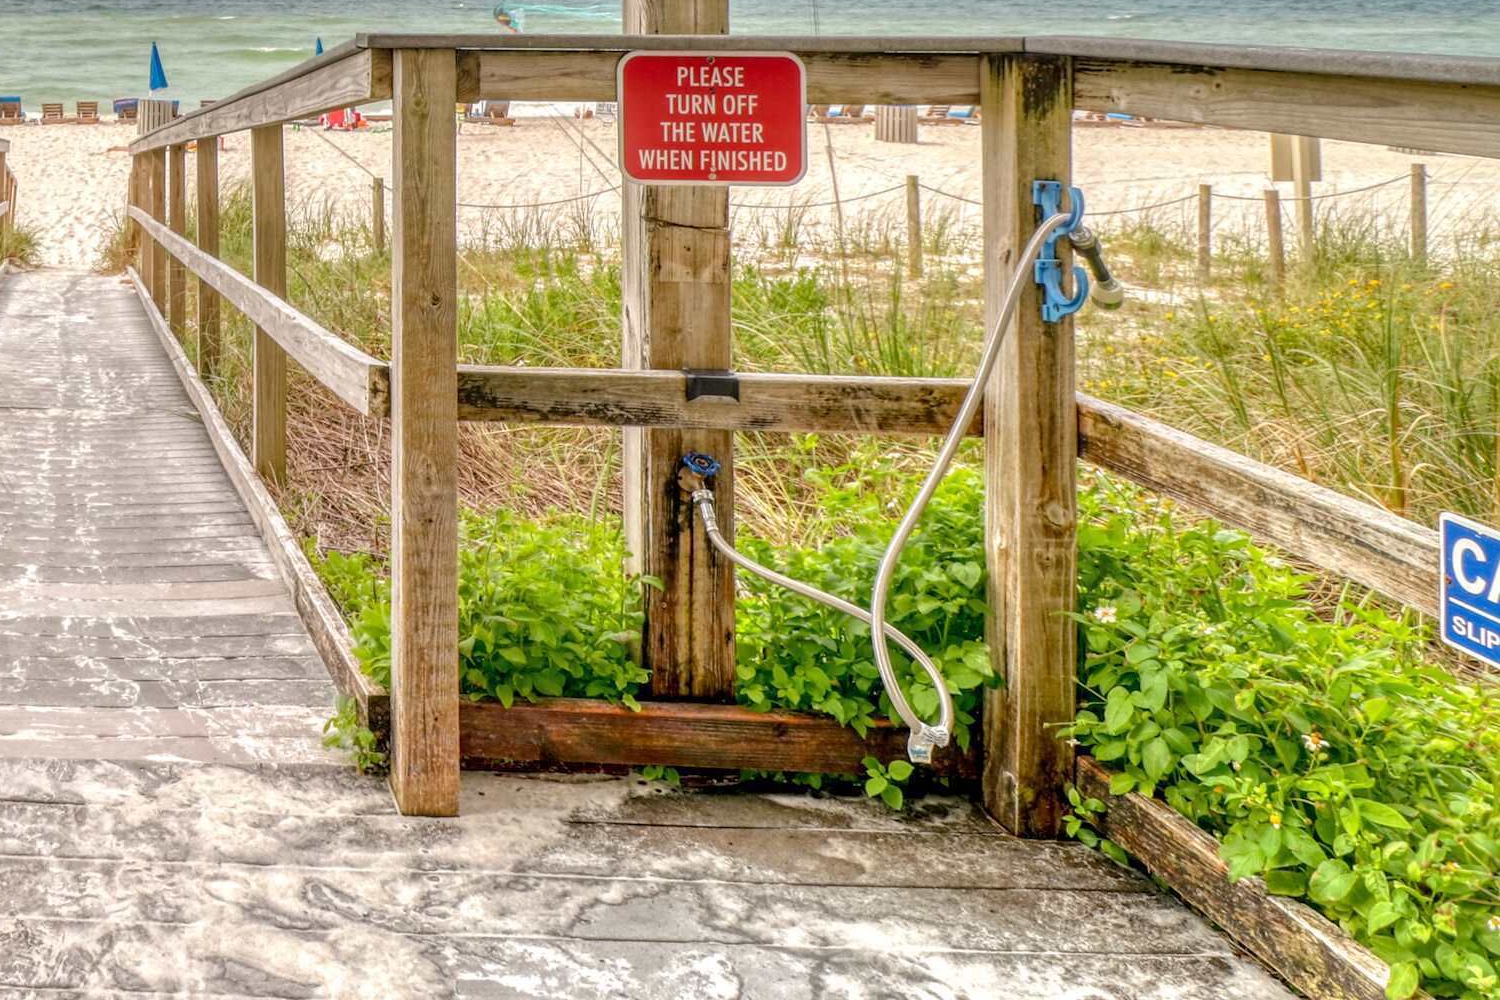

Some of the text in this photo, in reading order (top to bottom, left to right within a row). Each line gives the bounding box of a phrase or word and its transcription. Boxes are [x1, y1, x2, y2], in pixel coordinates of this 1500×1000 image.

[677, 67, 744, 87] PLEASE
[666, 94, 758, 115] TURN OFF
[660, 122, 764, 144] THE WATER
[639, 150, 787, 172] WHEN FINISHED
